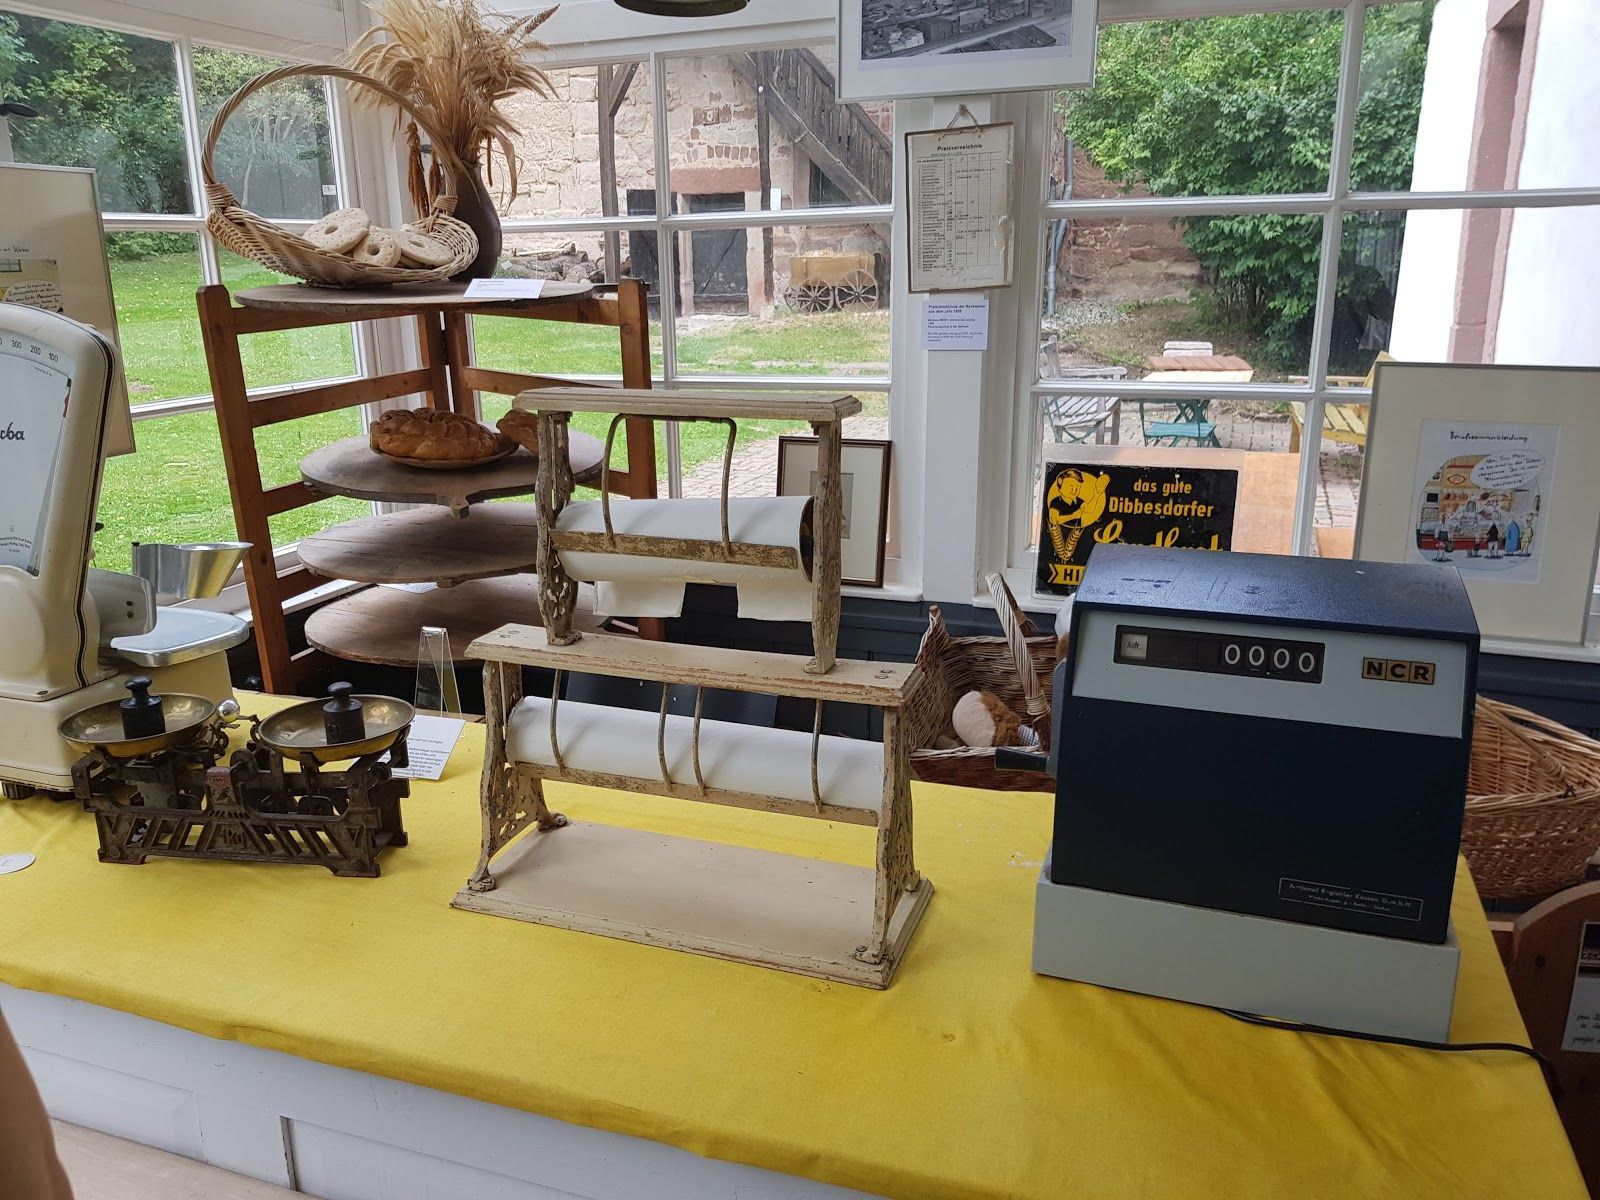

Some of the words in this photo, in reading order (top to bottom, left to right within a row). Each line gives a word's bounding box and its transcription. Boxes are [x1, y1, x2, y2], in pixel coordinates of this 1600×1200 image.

[11, 339, 22, 349] 300
[30, 345, 41, 355] 200
[48, 352, 59, 362] 100
[1133, 479, 1157, 493] das
[1162, 481, 1193, 496] gute
[1108, 496, 1214, 518] Dibbesdorfer
[1366, 659, 1431, 681] NCR
